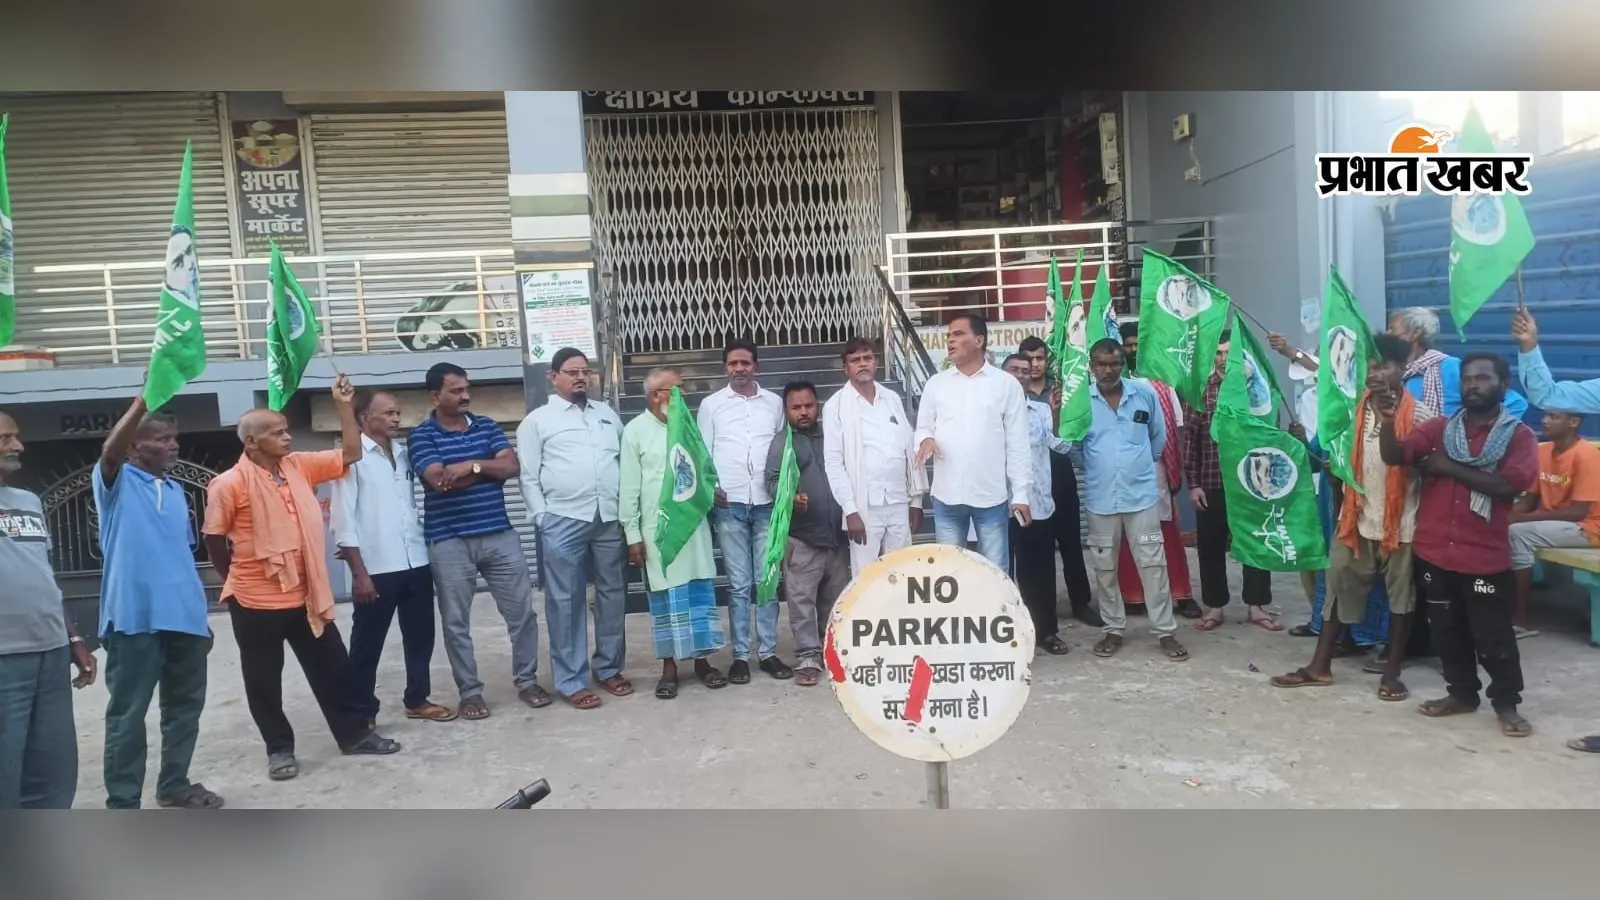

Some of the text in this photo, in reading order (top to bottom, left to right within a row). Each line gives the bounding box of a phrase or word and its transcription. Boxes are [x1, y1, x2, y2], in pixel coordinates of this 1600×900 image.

[241, 170, 300, 191] अपना
[246, 193, 299, 214] सूपर
[907, 575, 959, 604] NO
[852, 615, 1015, 647] PARKING
[852, 656, 884, 687] यहाँ
[969, 661, 1016, 682] करना
[929, 698, 963, 719] मना
